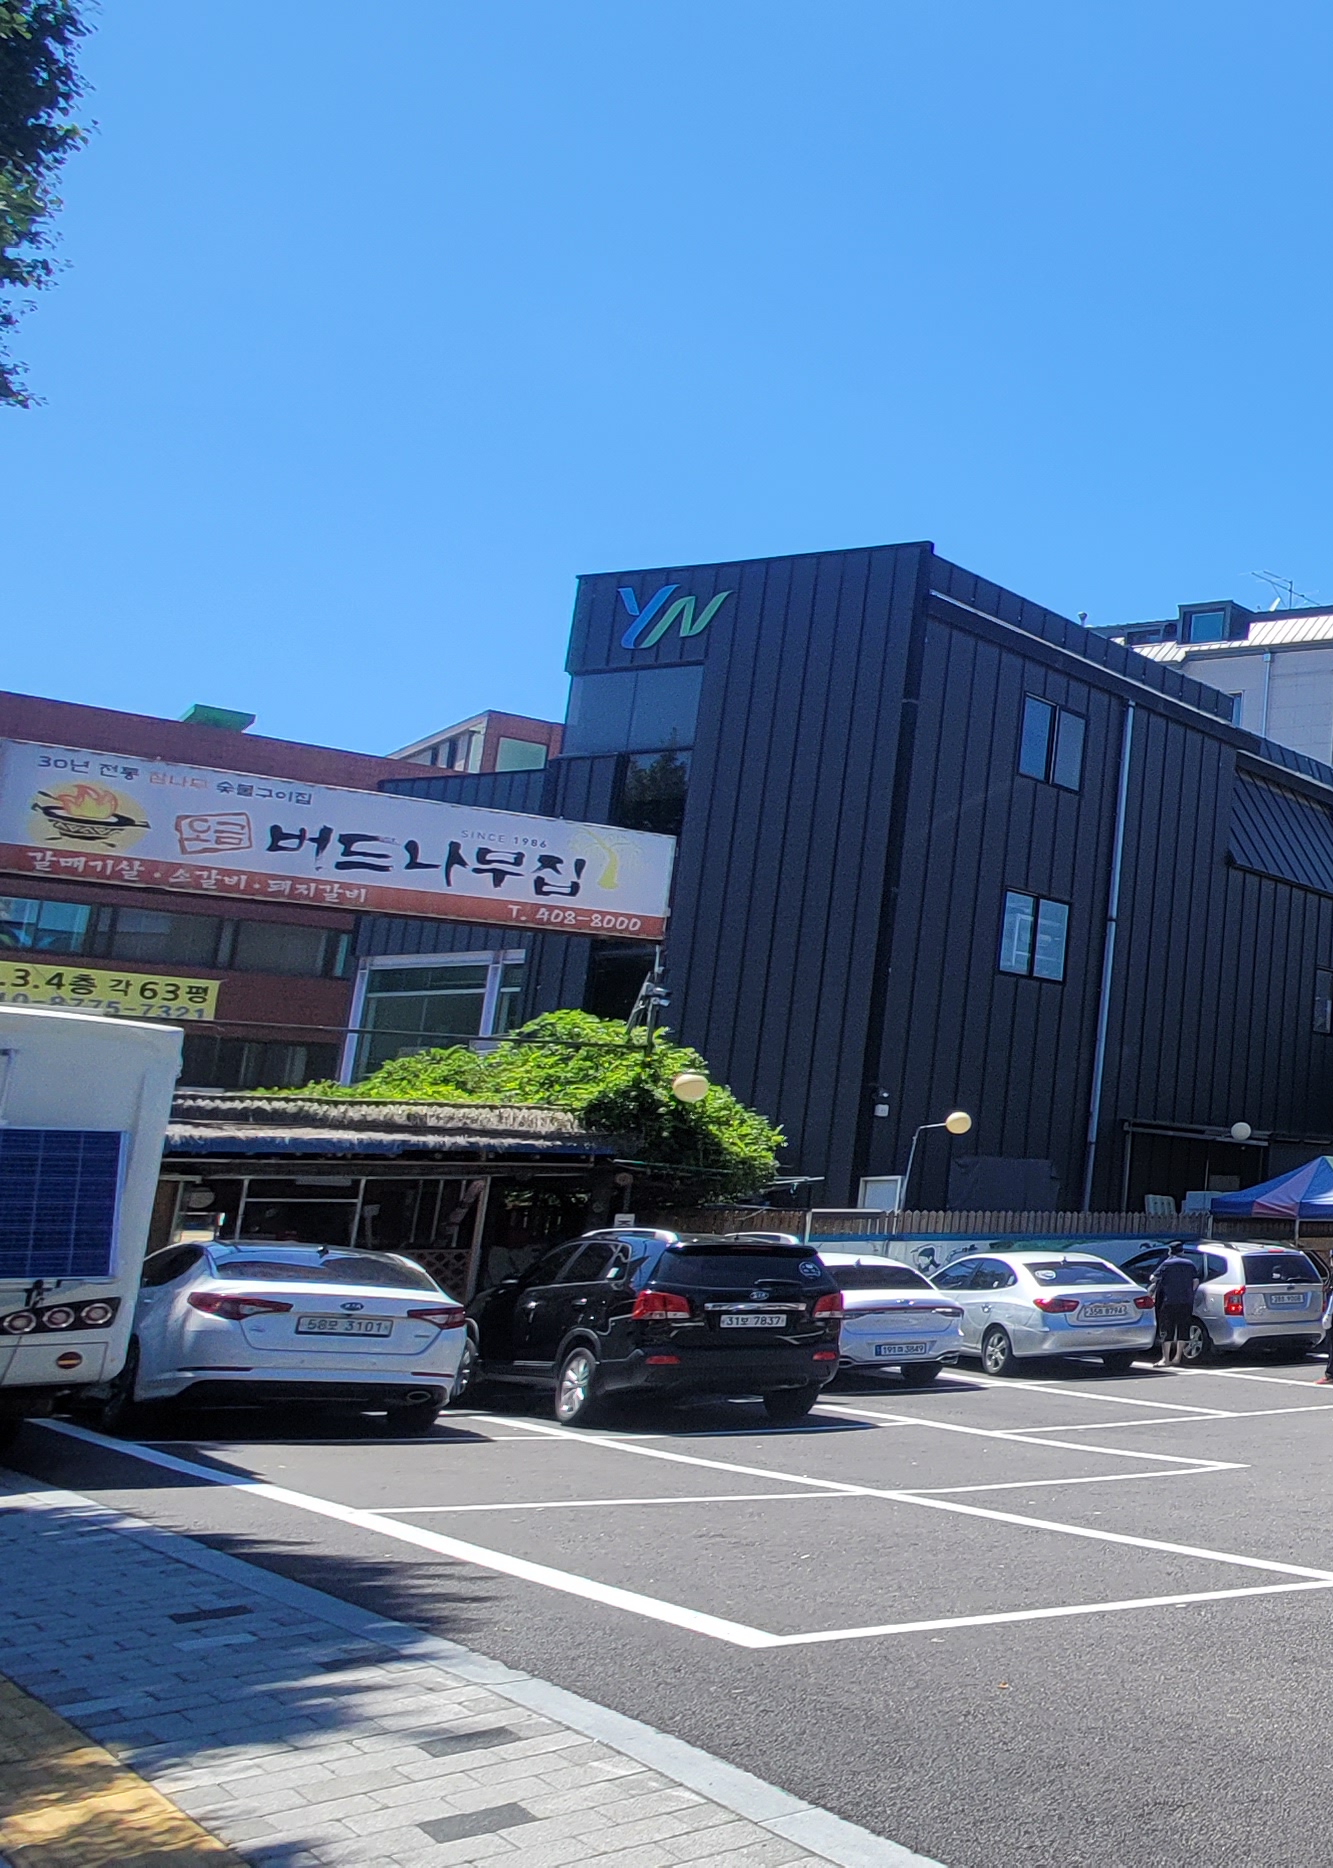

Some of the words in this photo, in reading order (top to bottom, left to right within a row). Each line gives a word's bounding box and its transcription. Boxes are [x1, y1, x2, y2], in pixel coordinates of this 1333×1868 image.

[617, 584, 735, 649] YN
[37, 755, 90, 774] 30년
[215, 780, 313, 806] 숯불구이집
[183, 816, 247, 847] 오금
[461, 829, 506, 844] SINCE
[513, 836, 547, 849] 1986
[265, 824, 586, 897] 버드나무집
[28, 851, 145, 880] 갈매기살
[168, 867, 248, 891] 소갈비
[267, 877, 367, 904] 돼지갈비
[508, 905, 527, 921] T.
[535, 908, 642, 932] 408-8000
[108, 978, 133, 997] 각
[138, 981, 210, 1004] 63평
[344, 1321, 383, 1333] 3101
[754, 1315, 781, 1325] 7837
